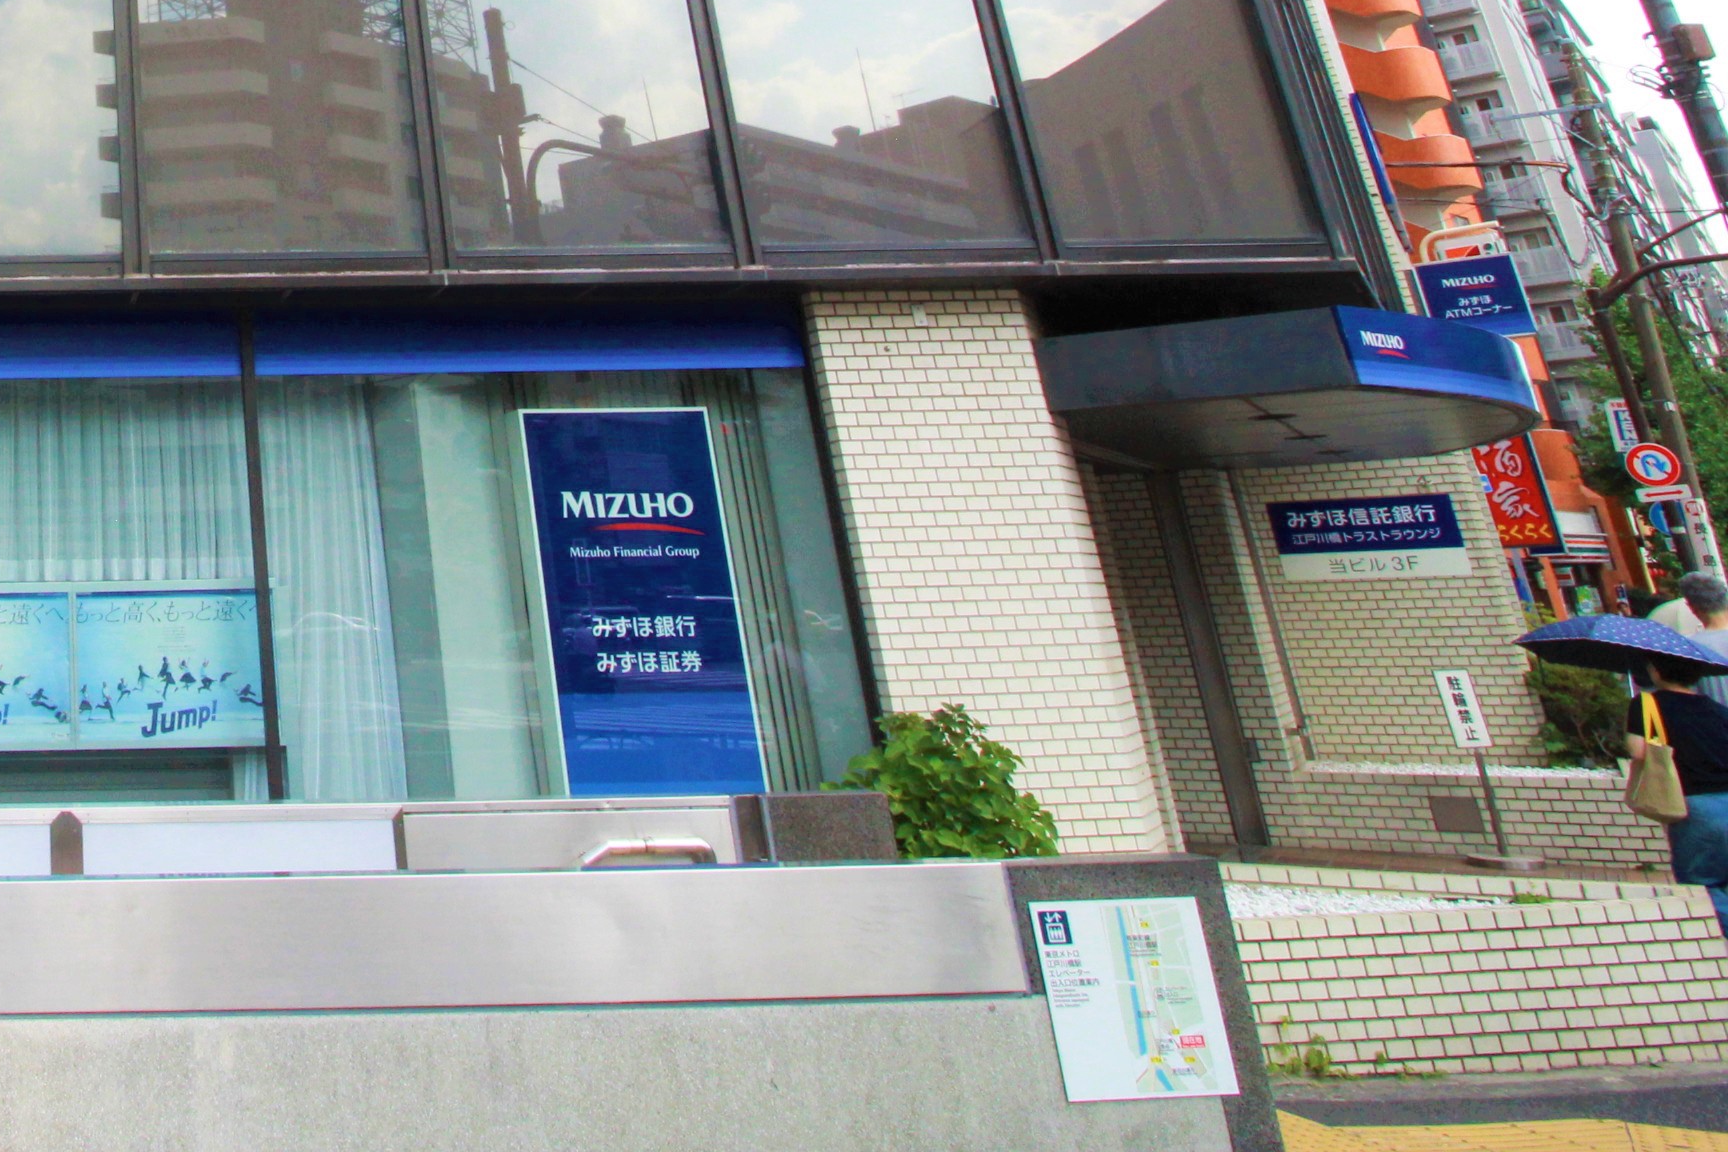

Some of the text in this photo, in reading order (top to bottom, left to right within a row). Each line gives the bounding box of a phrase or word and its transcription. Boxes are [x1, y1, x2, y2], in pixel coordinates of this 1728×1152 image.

[1441, 274, 1495, 288] MIZUHO
[1458, 294, 1492, 306] みずほ
[1445, 304, 1513, 319] ATMコーナー
[1360, 330, 1404, 350] MIZUHO
[561, 491, 694, 518] MIZUHO
[1286, 505, 1435, 528] みずほ信託銀行
[1292, 527, 1441, 545] 江戸川橋トラストラウンジ
[570, 546, 700, 559] Mizuho Financial Group
[592, 615, 696, 638] みずほ銀行
[597, 651, 702, 673] みずほ証券
[141, 700, 217, 737] Jump!
